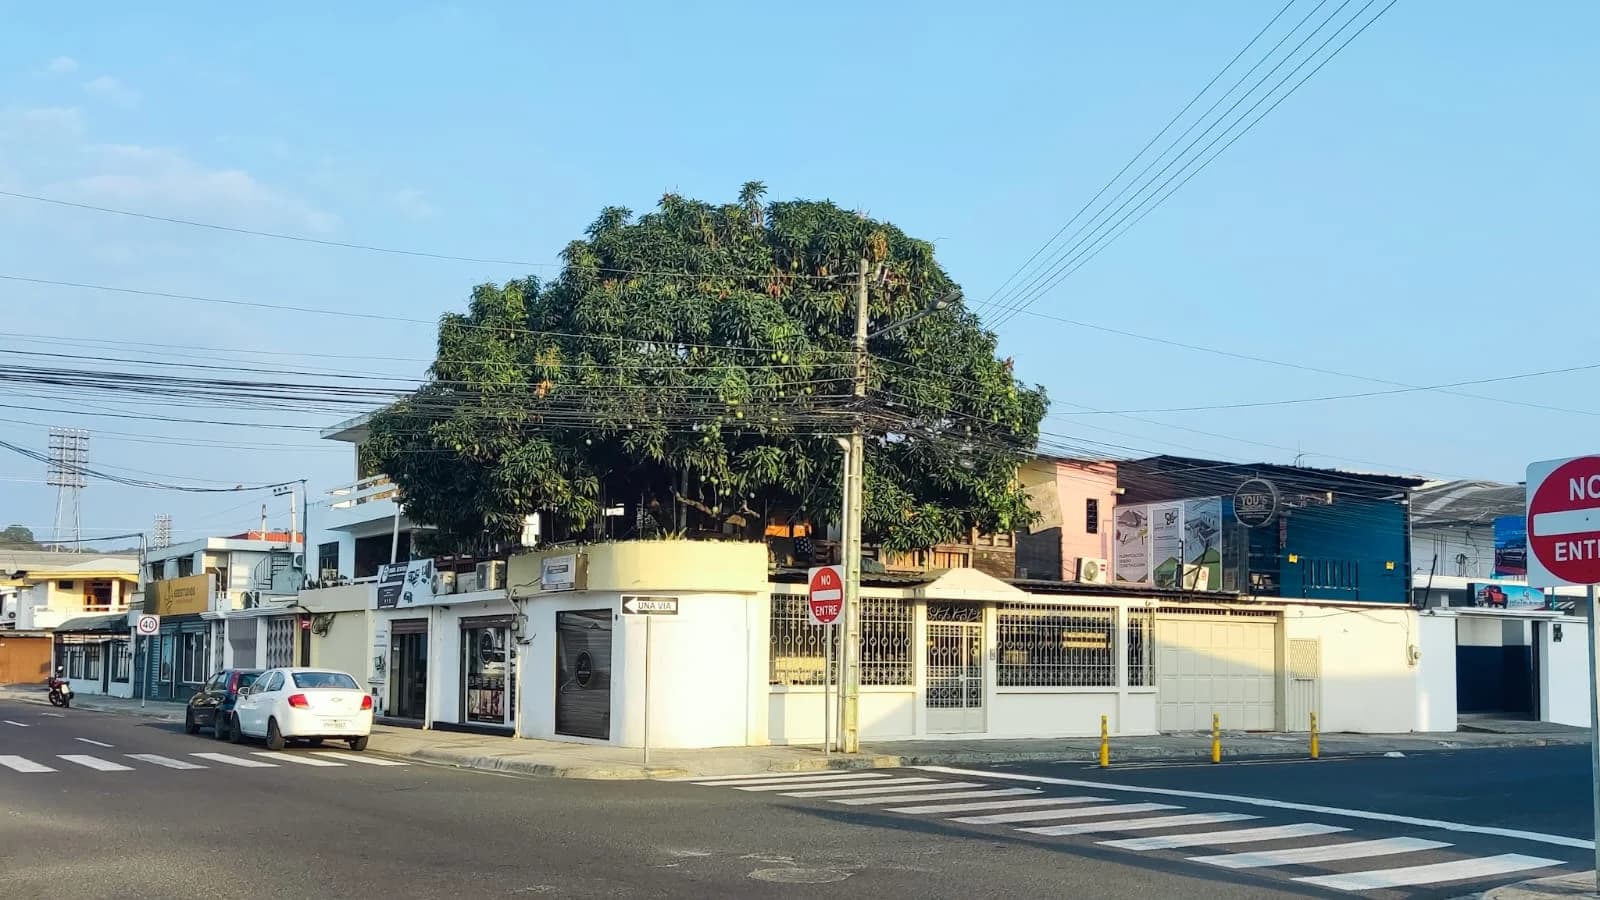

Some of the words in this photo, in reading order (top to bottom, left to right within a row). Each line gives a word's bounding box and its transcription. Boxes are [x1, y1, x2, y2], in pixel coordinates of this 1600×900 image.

[1569, 475, 1600, 501] NO
[1555, 539, 1600, 562] ENT
[820, 575, 831, 586] NO
[638, 602, 655, 610] UNA
[658, 602, 671, 610] VIA
[815, 604, 838, 617] ENTRE
[143, 620, 154, 630] 40
